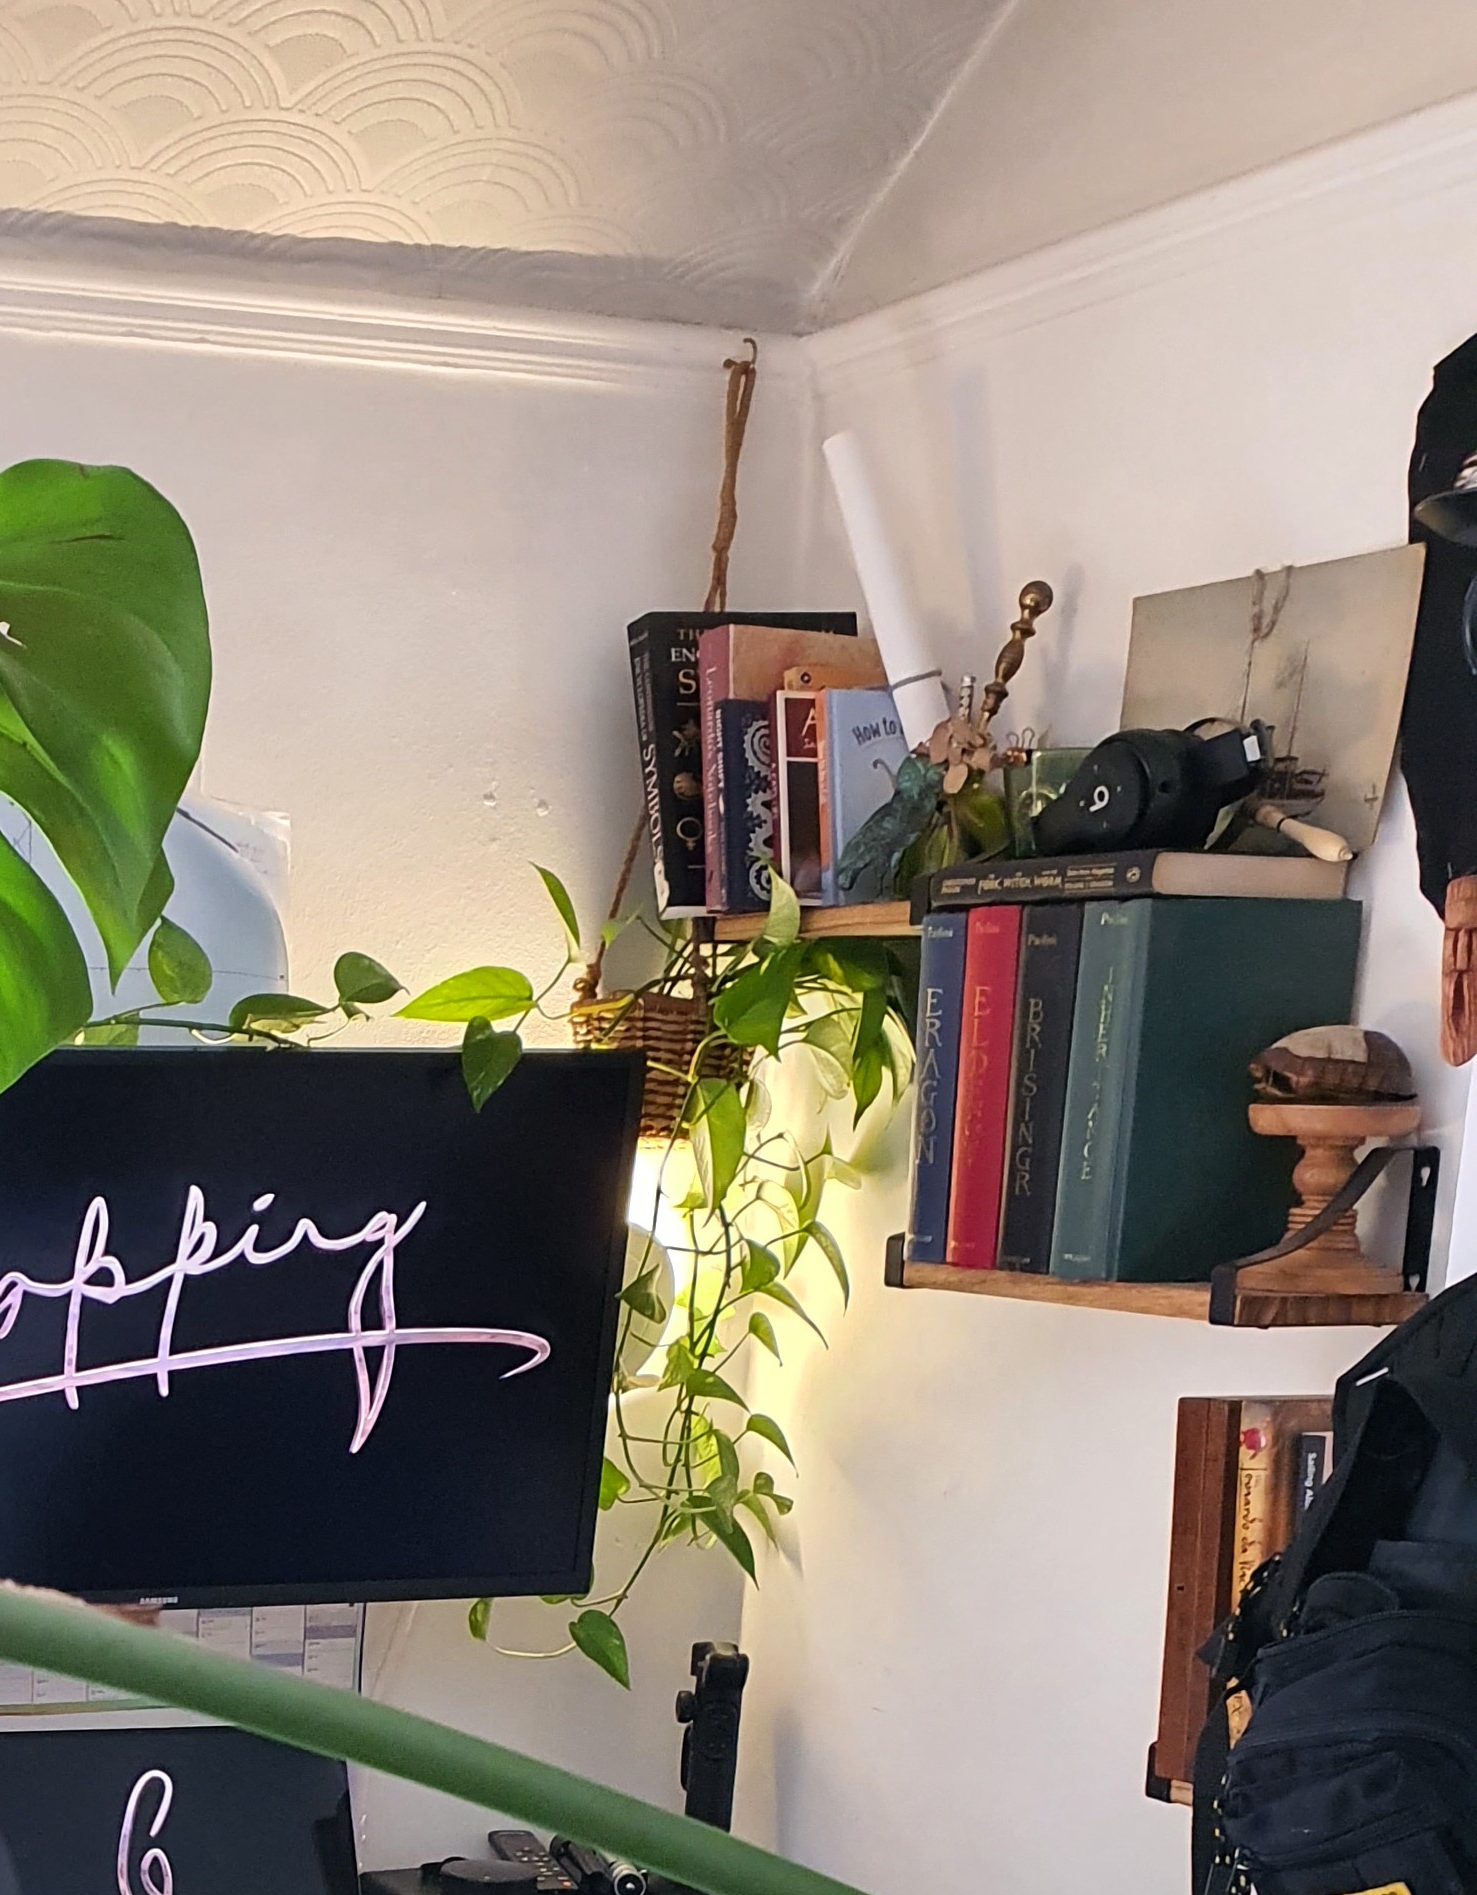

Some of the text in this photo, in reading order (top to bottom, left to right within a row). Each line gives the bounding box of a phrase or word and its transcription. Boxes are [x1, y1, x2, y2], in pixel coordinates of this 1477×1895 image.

[643, 743, 665, 863] SYMBOLS
[915, 986, 944, 1165] ERAGON
[1015, 998, 1044, 1198] BRISINGR
[1304, 1452, 1317, 1488] Sailing
